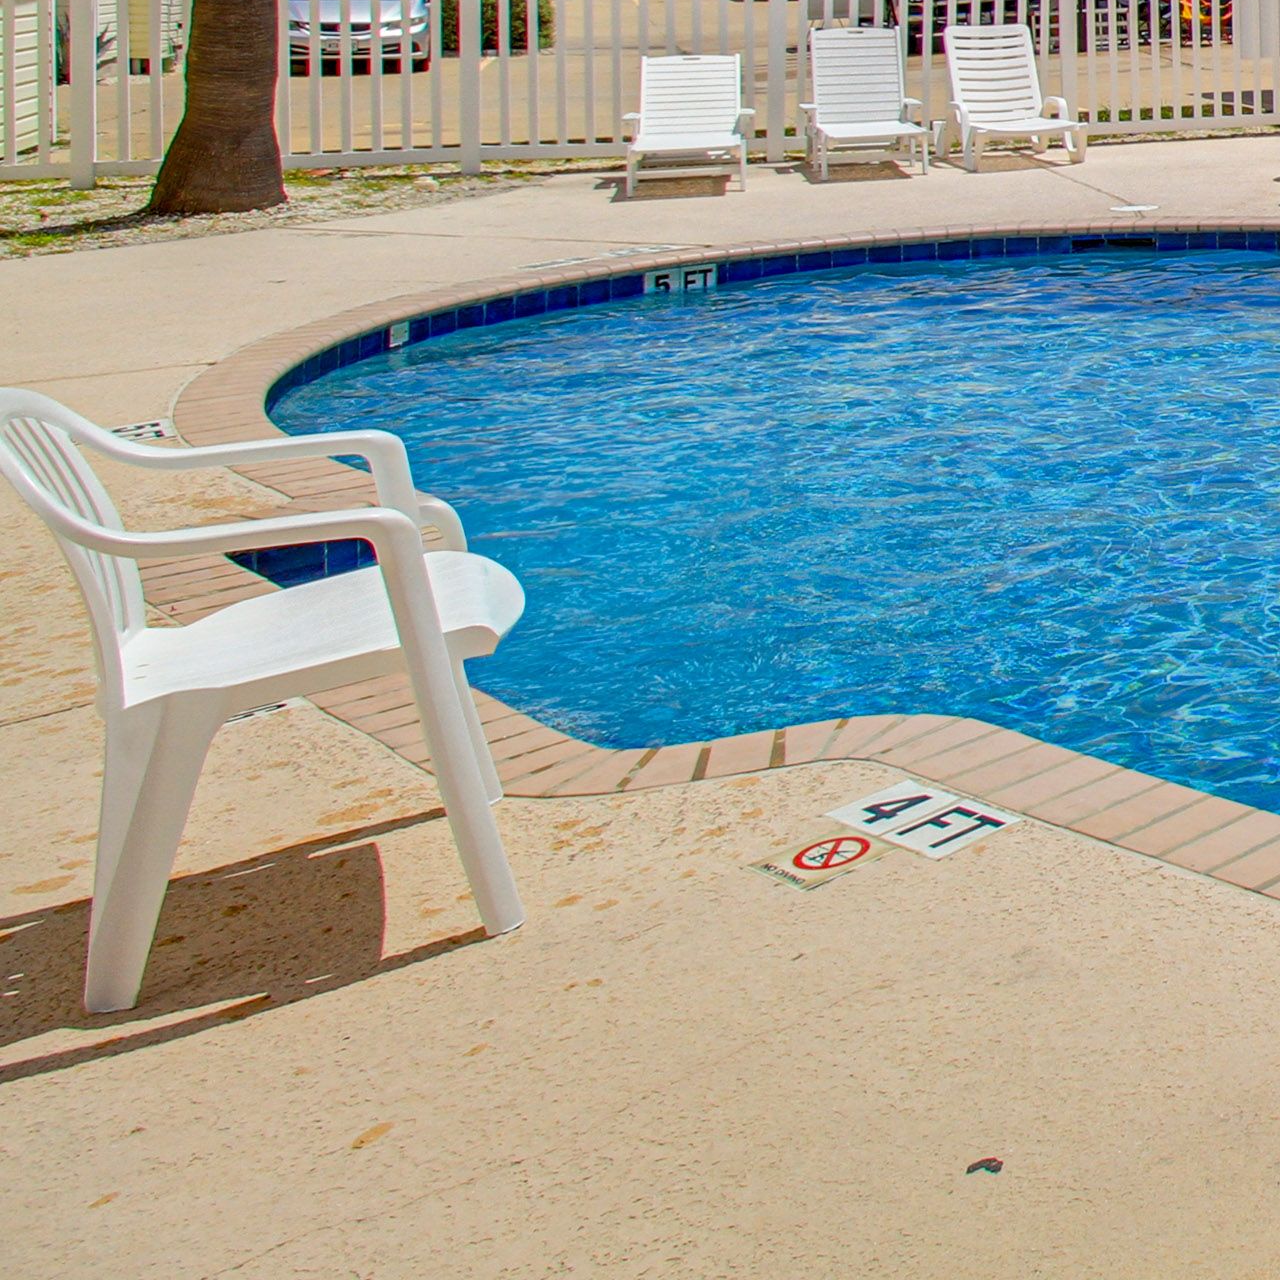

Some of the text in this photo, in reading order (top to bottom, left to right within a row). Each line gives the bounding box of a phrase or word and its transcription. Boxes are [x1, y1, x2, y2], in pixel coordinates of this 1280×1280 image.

[655, 268, 713, 293] 5 FT
[862, 794, 1006, 848] 4 FT
[761, 863, 778, 872] NO
